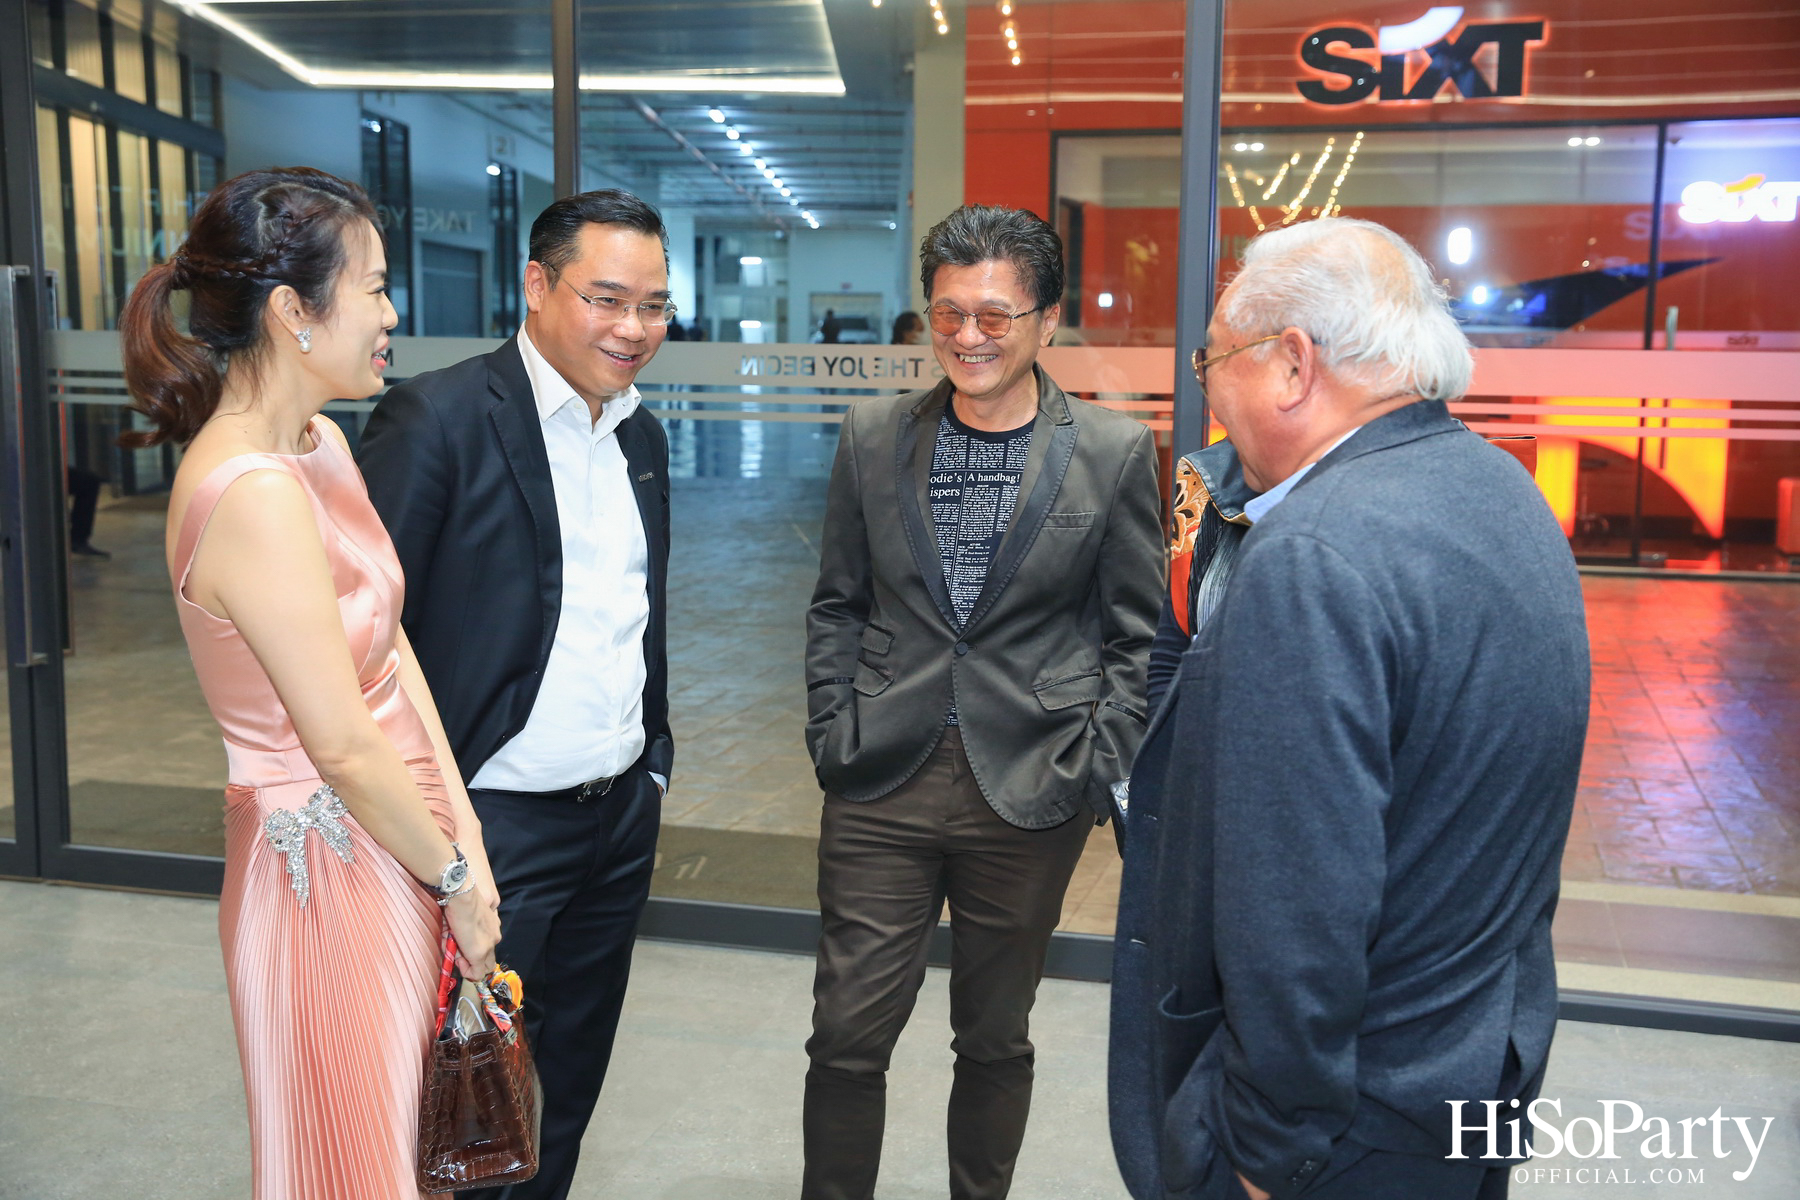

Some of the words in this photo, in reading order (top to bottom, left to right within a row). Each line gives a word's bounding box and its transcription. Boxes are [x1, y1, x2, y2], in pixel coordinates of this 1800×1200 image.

[1295, 6, 1549, 107] SIXT
[967, 472, 976, 482] A
[977, 472, 1021, 485] handbag!
